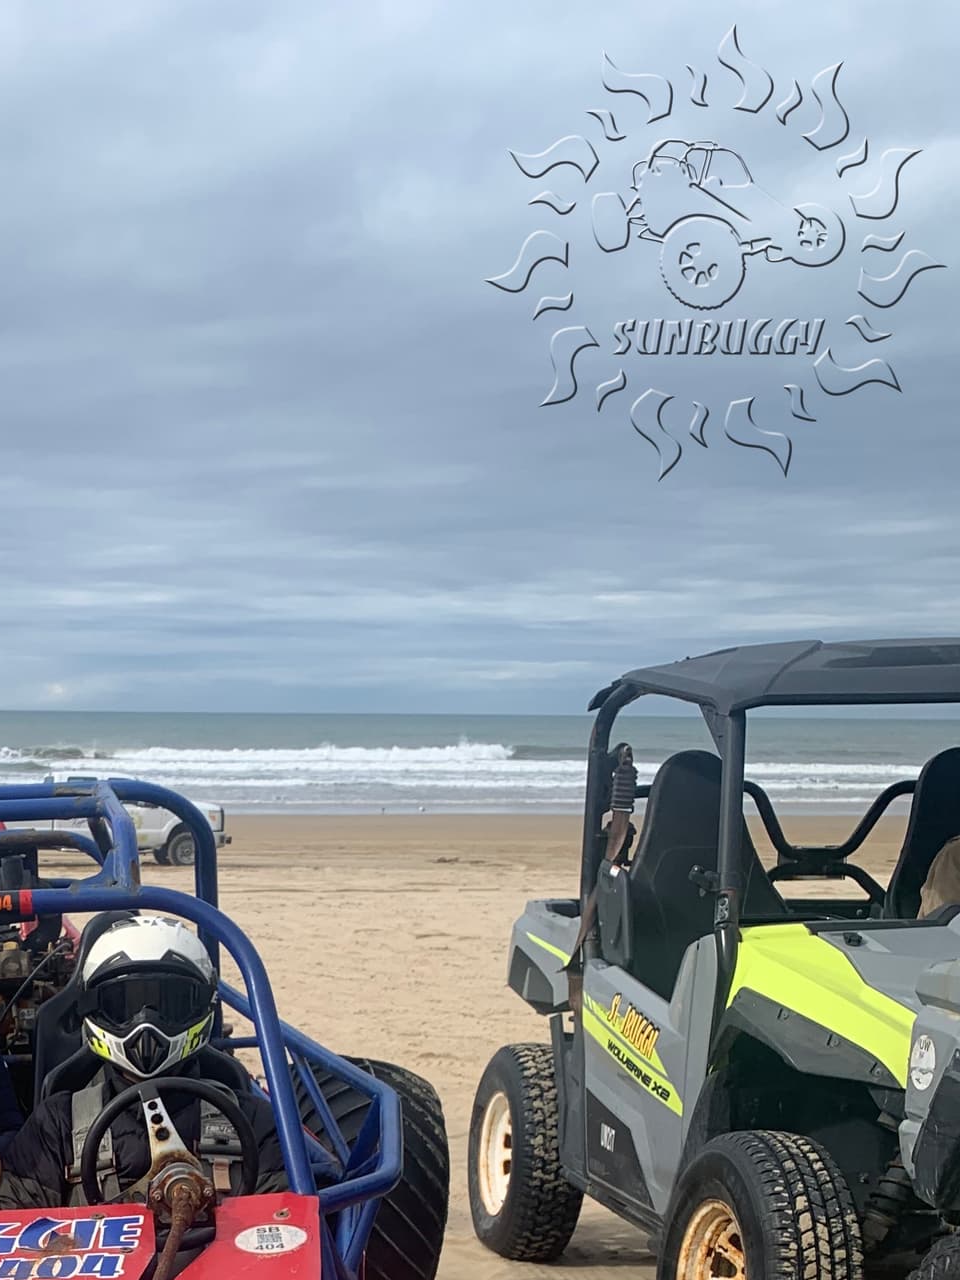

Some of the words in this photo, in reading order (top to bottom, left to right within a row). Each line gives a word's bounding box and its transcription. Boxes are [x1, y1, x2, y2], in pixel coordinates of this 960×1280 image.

[607, 1039, 652, 1088] WOLVERINE
[651, 1081, 670, 1102] X2
[256, 1226, 280, 1234] SB
[255, 1243, 285, 1251] 404
